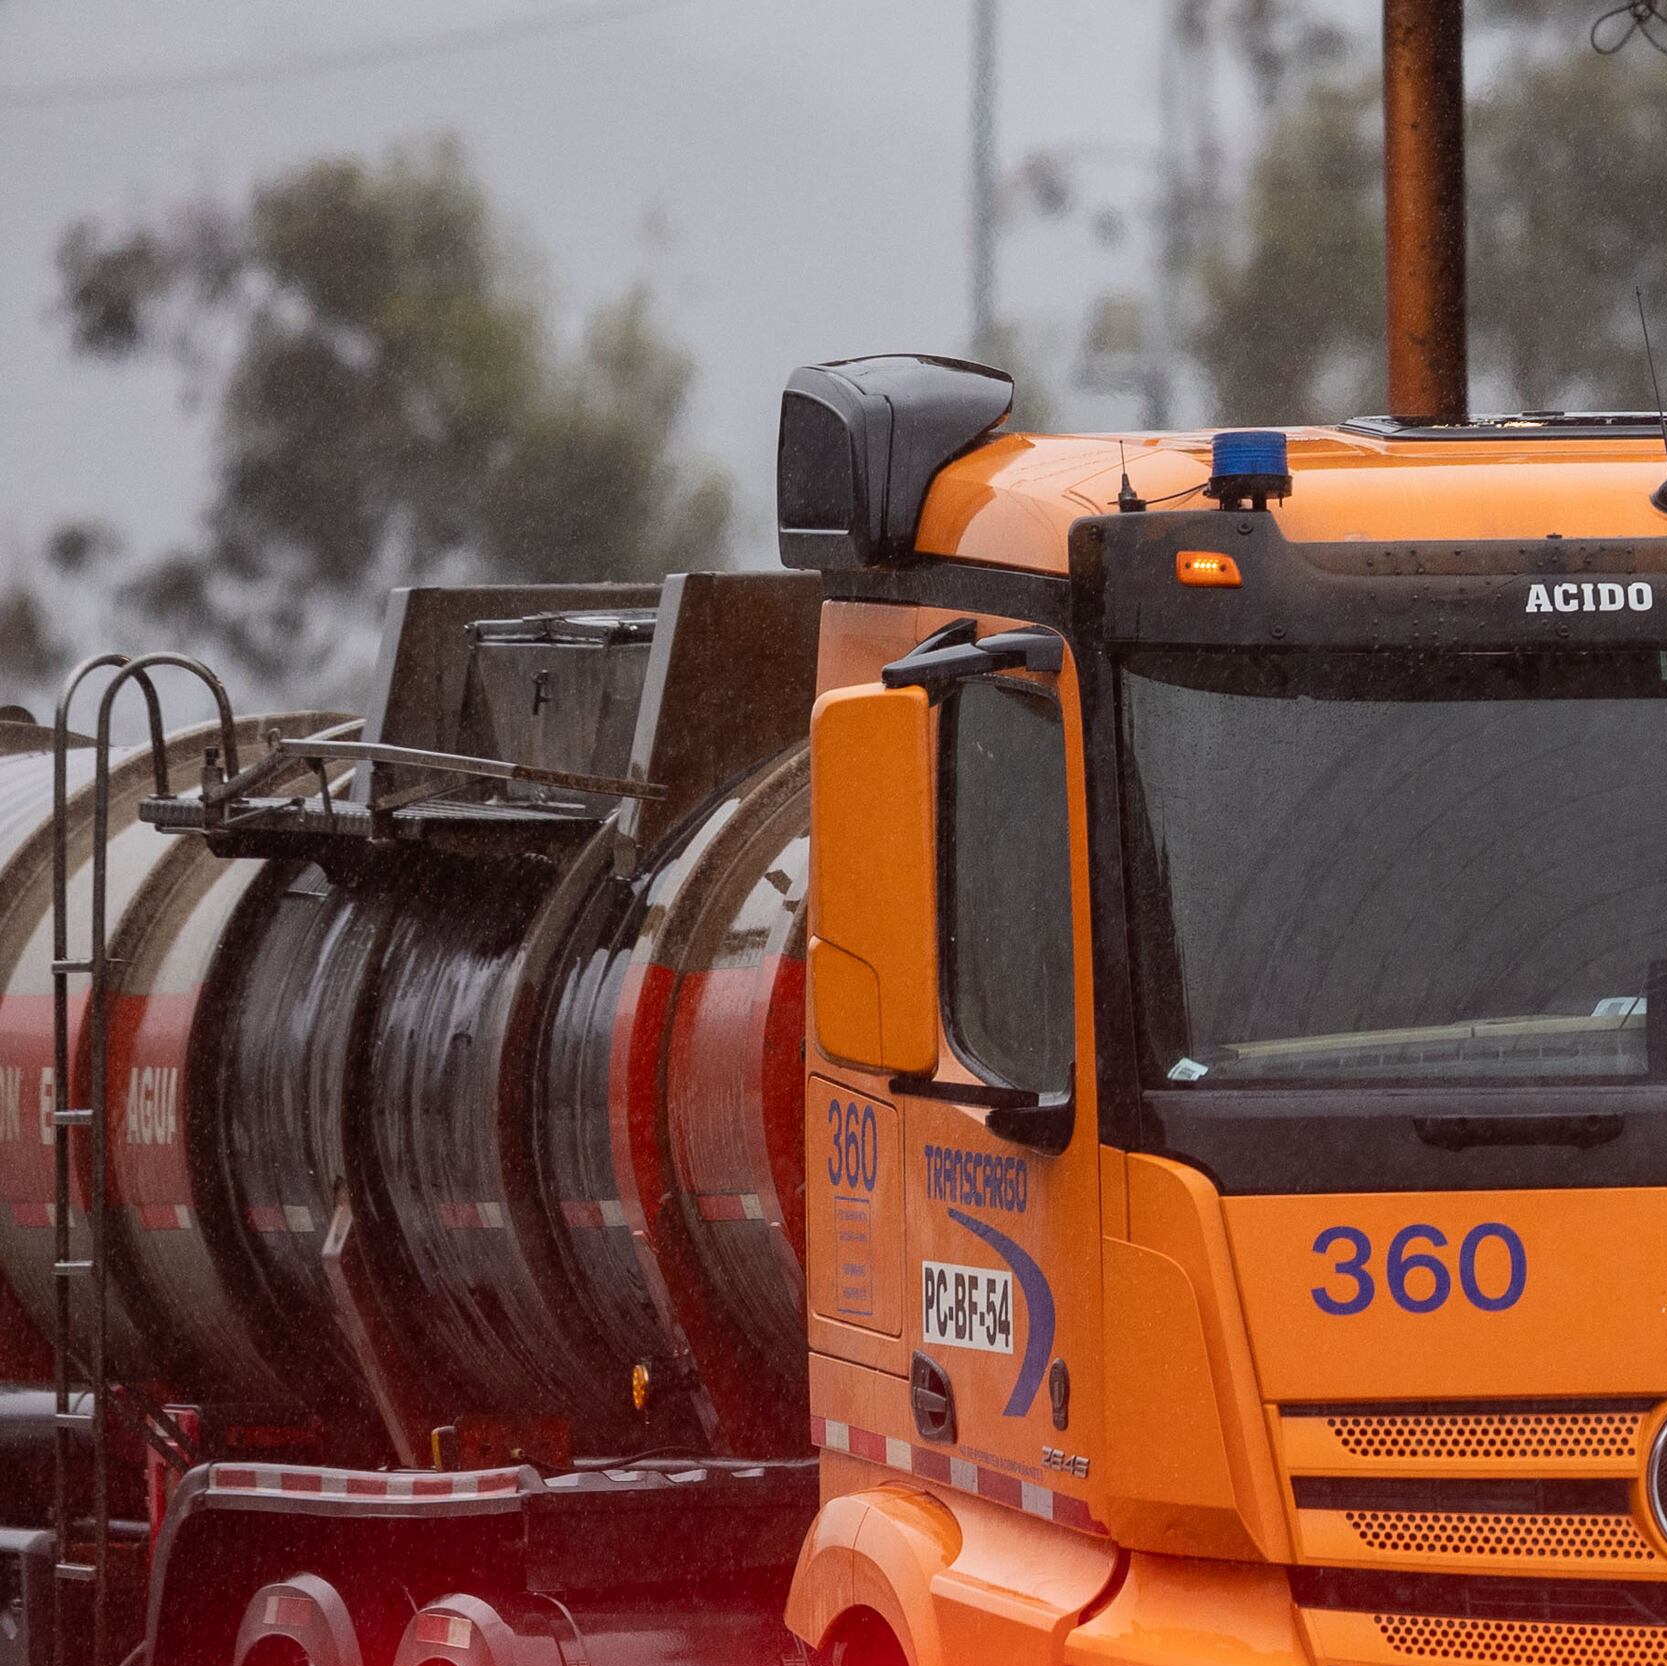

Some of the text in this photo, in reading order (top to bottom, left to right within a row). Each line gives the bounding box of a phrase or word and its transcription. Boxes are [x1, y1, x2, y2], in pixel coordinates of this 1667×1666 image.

[1525, 581, 1654, 613] ACIDO
[827, 1098, 878, 1192] 360
[924, 1144, 1028, 1214] TRANSCARGO
[924, 1267, 1011, 1348] PC-BF-54
[1310, 1221, 1528, 1316] 360
